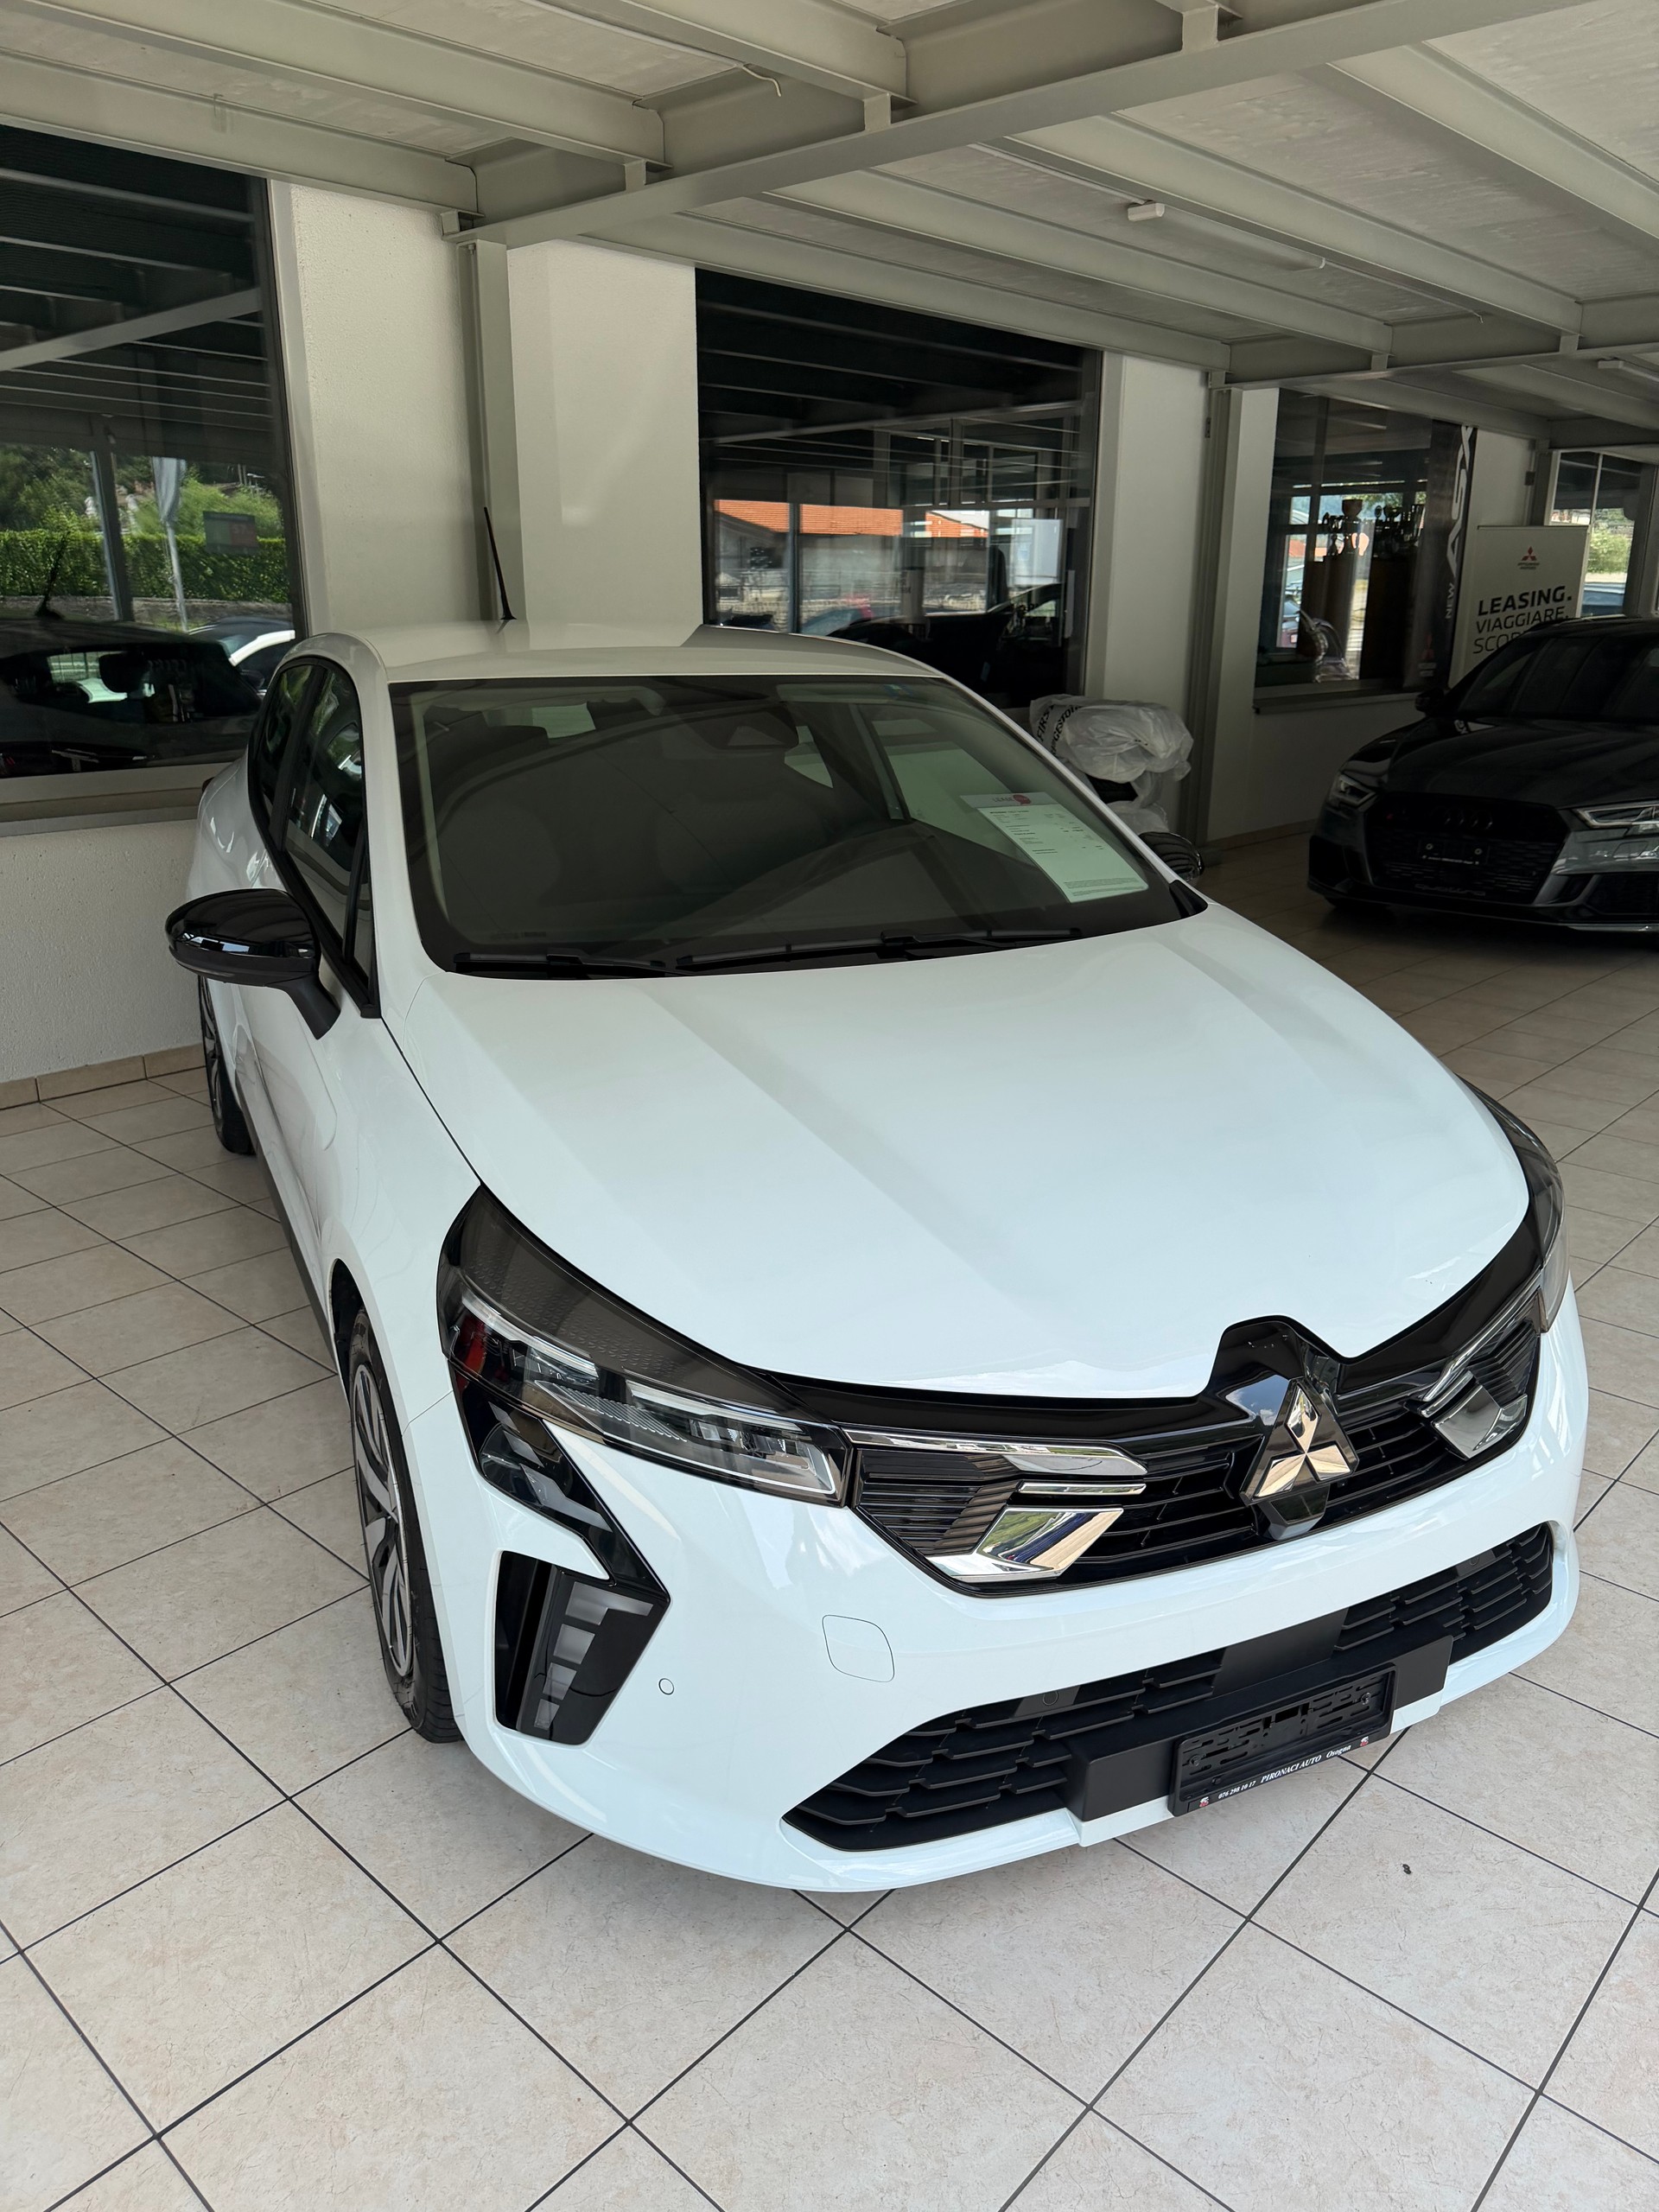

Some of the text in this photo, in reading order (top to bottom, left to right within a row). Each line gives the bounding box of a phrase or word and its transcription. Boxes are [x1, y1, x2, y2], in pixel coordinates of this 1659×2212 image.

[1445, 582, 1456, 620] NEW
[1478, 586, 1572, 616] LEASING.
[1260, 1763, 1300, 1783] PIRONACI
[1299, 1755, 1322, 1769] AUTO
[1325, 1745, 1352, 1758] Osogna
